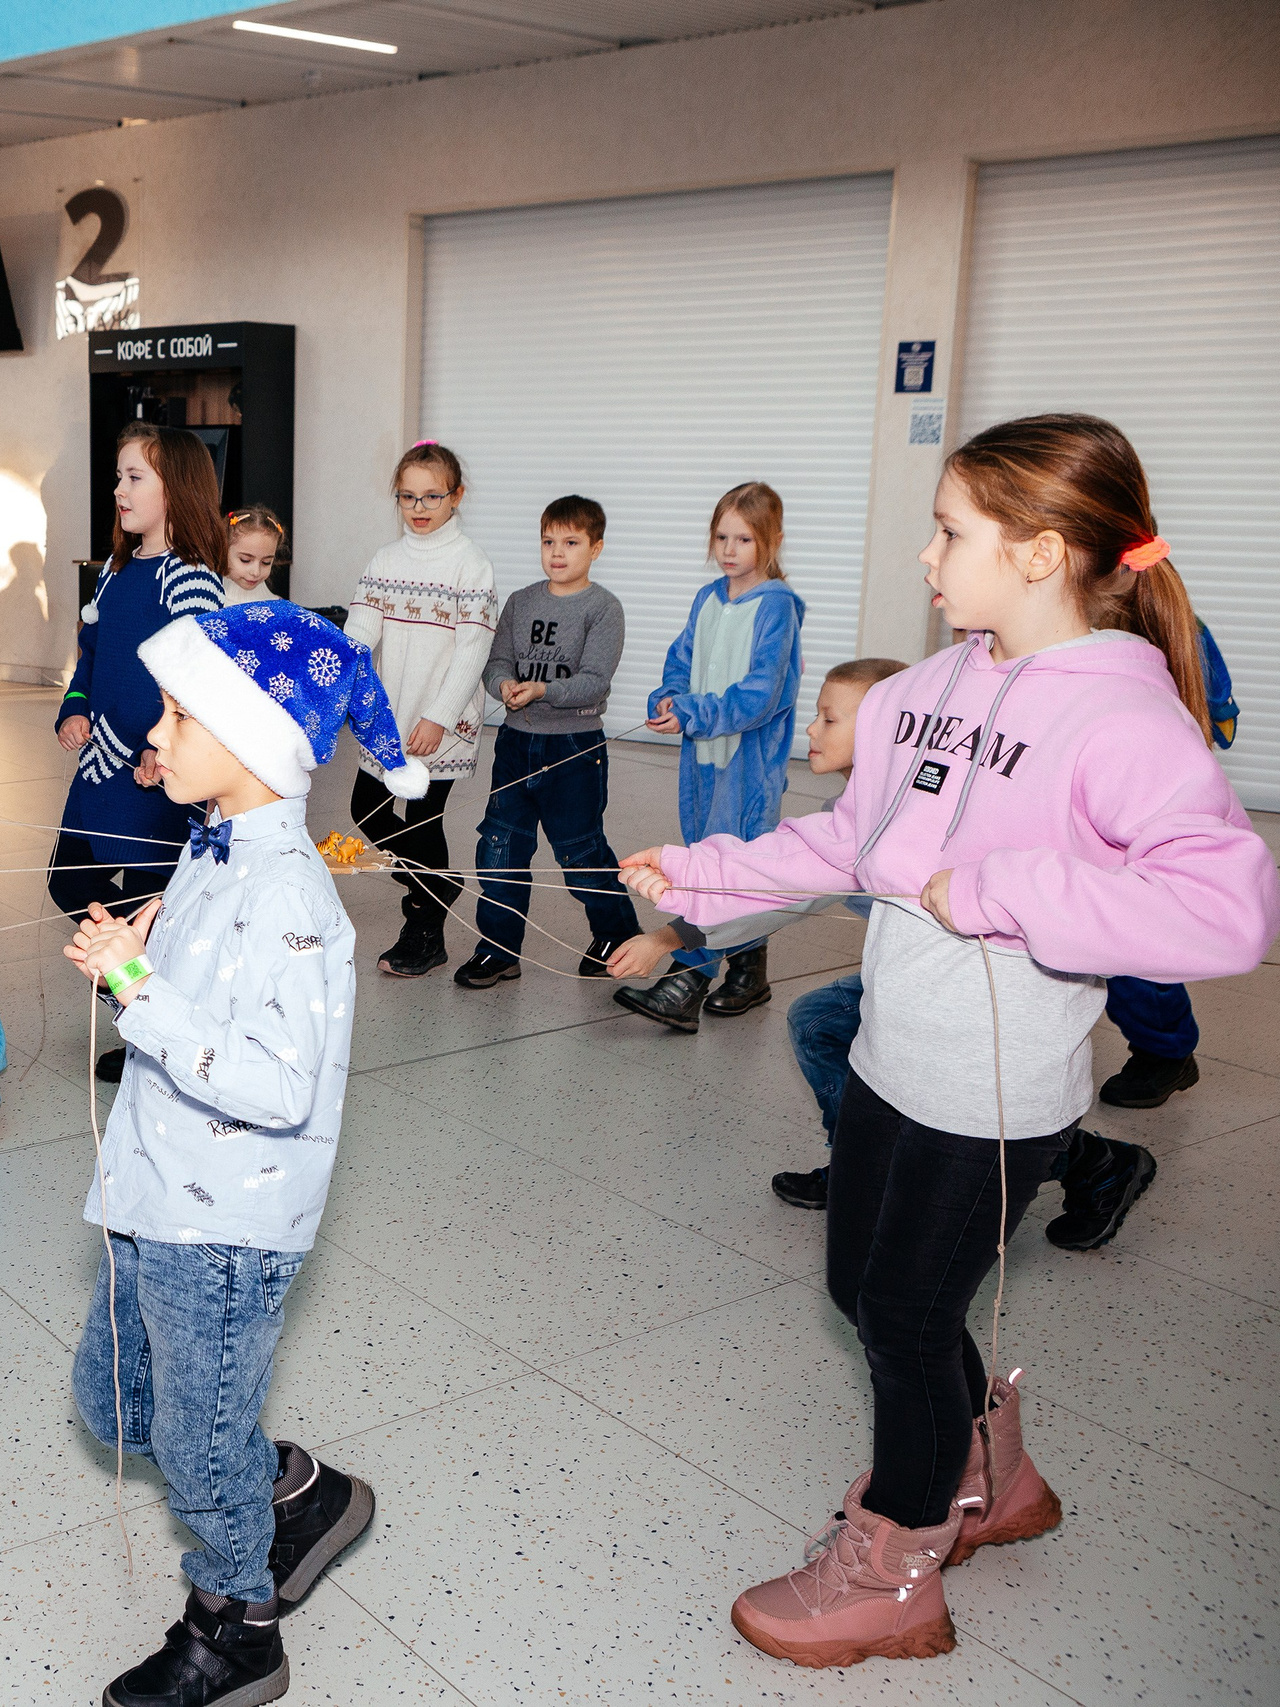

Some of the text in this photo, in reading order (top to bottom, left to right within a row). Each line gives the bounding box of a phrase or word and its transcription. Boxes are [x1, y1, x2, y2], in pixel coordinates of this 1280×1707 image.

[65, 186, 131, 300] 2
[117, 334, 212, 360] КОФЕ С СОБОЙ
[530, 619, 558, 646] BE
[515, 661, 572, 684] WILD
[894, 711, 1031, 780] DREAM
